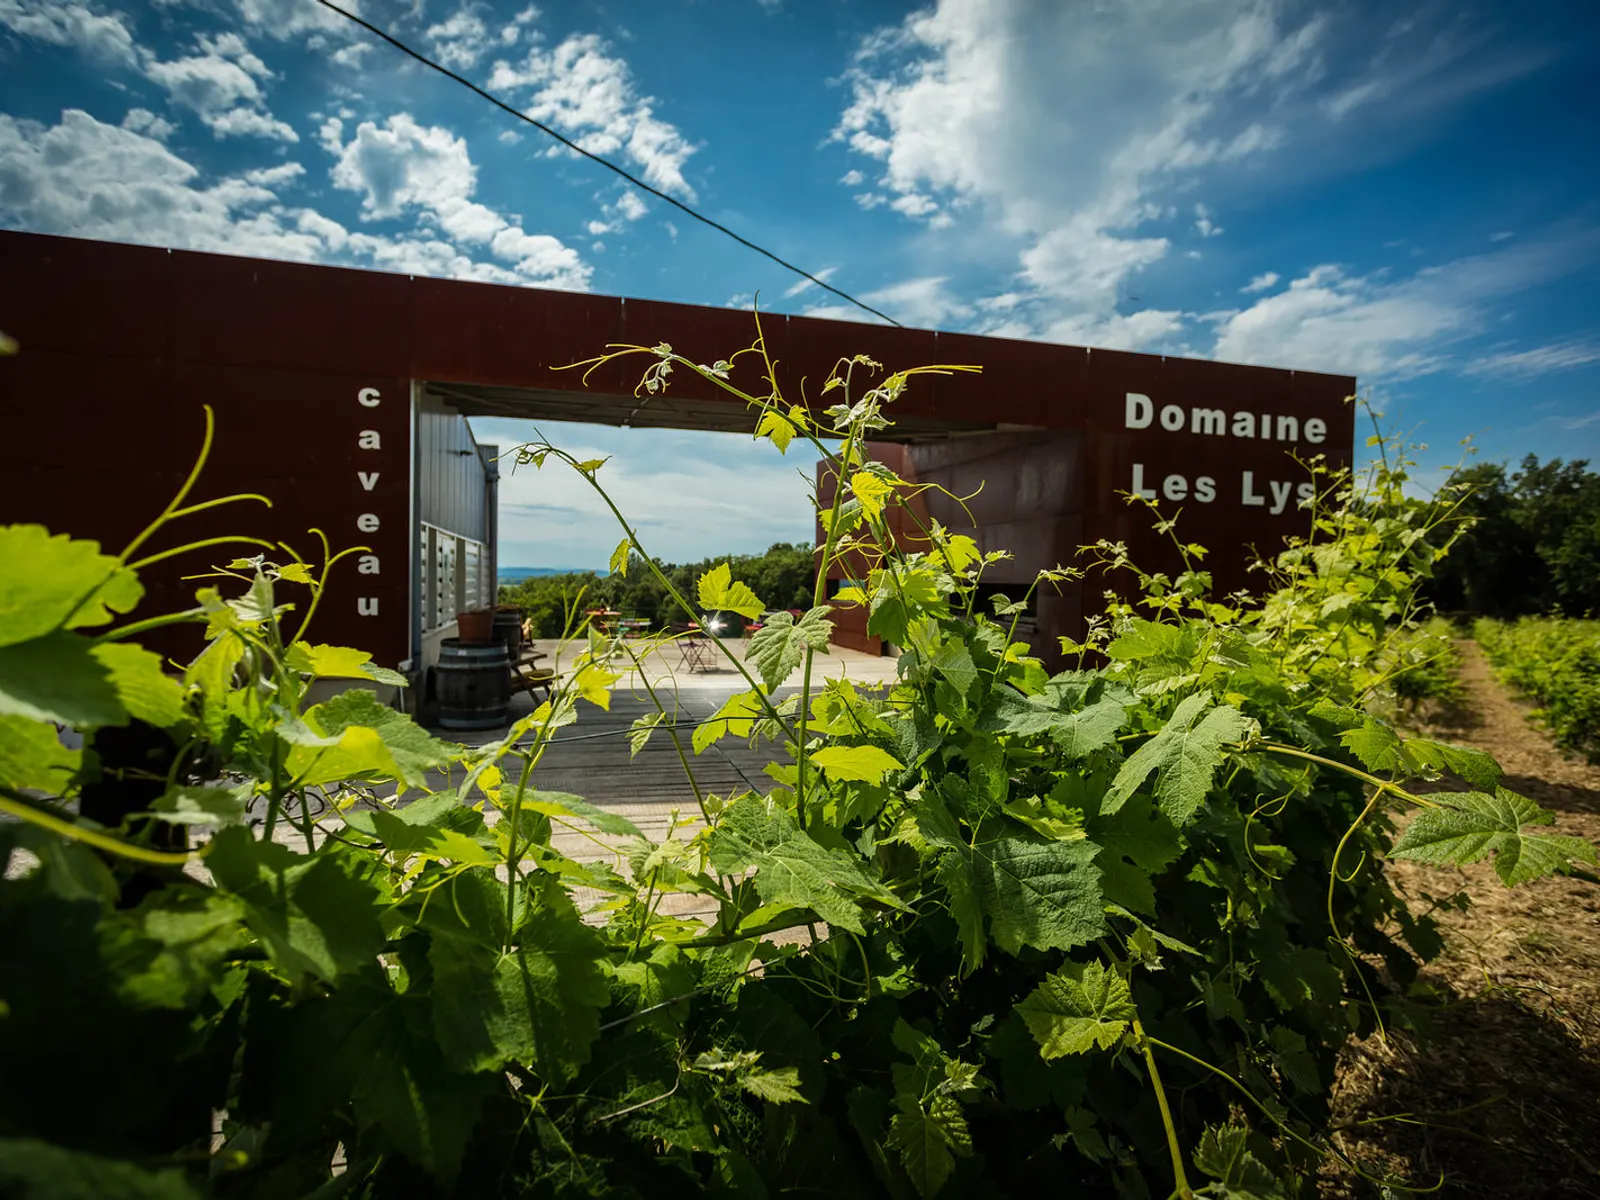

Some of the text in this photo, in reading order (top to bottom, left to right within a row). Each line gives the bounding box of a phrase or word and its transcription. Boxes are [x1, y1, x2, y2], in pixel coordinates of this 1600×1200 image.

[1124, 392, 1327, 444] Domaine
[356, 387, 381, 617] caveau
[1132, 463, 1217, 503] Les
